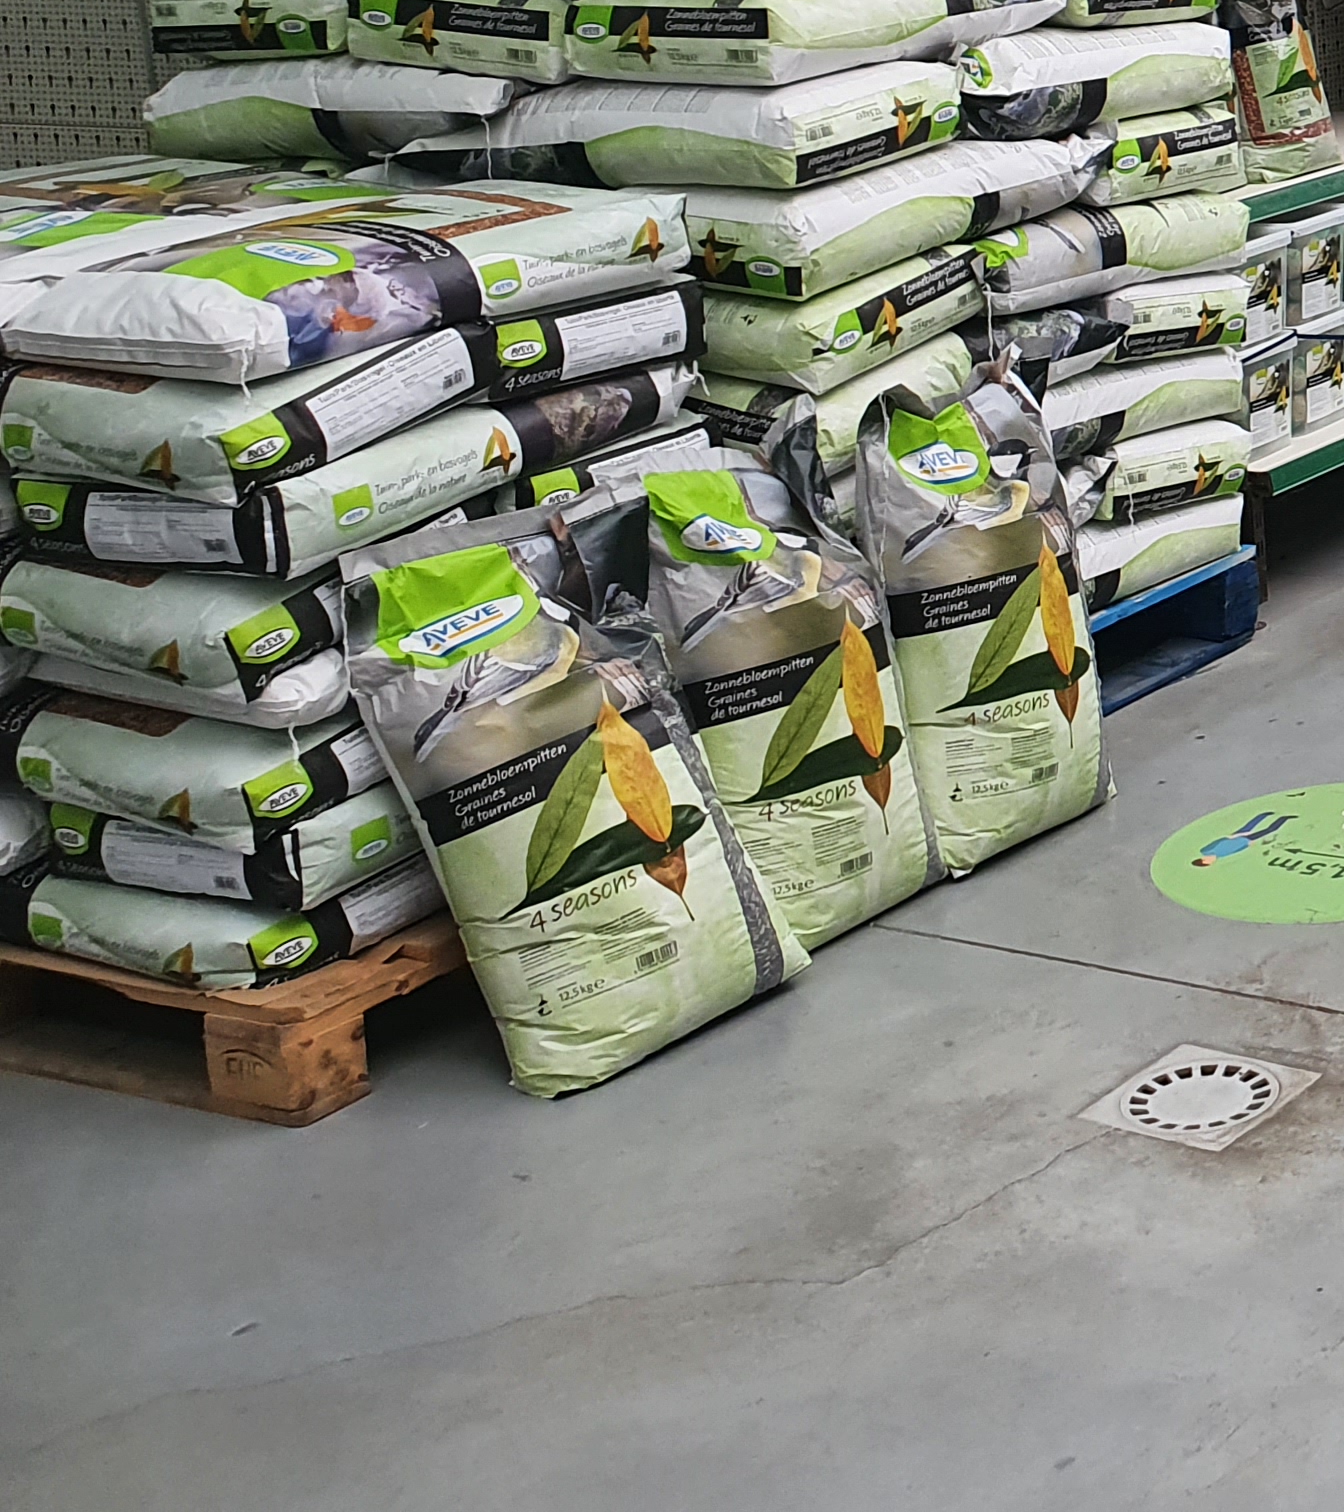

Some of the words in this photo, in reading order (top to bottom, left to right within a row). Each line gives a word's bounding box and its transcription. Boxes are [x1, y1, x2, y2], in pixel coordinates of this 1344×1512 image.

[511, 344, 536, 358] AVEVE
[505, 376, 516, 392] 4
[516, 366, 562, 388] seasons
[247, 440, 277, 459] AVEVE
[921, 572, 1017, 605] Zonnebloempitten
[923, 599, 969, 618] Graines
[925, 613, 939, 630] de
[940, 604, 991, 627] tournesol
[421, 602, 500, 648] AVEVE
[255, 633, 286, 657] AVEVE
[705, 656, 814, 695] Zonnebloempitten
[708, 686, 757, 709] Graines
[711, 704, 725, 721] de
[727, 691, 783, 718] tournesol
[983, 693, 1050, 723] seasons
[448, 744, 567, 804] Zonnebloempitten
[269, 787, 299, 809] AVEVE
[455, 787, 506, 817] Graines
[461, 809, 476, 830] de
[477, 786, 536, 825] tournesol
[758, 800, 775, 823] 4
[778, 779, 857, 816] seasons
[530, 910, 547, 934] 4
[551, 867, 638, 923] seasons
[274, 941, 305, 963] AVEVE
